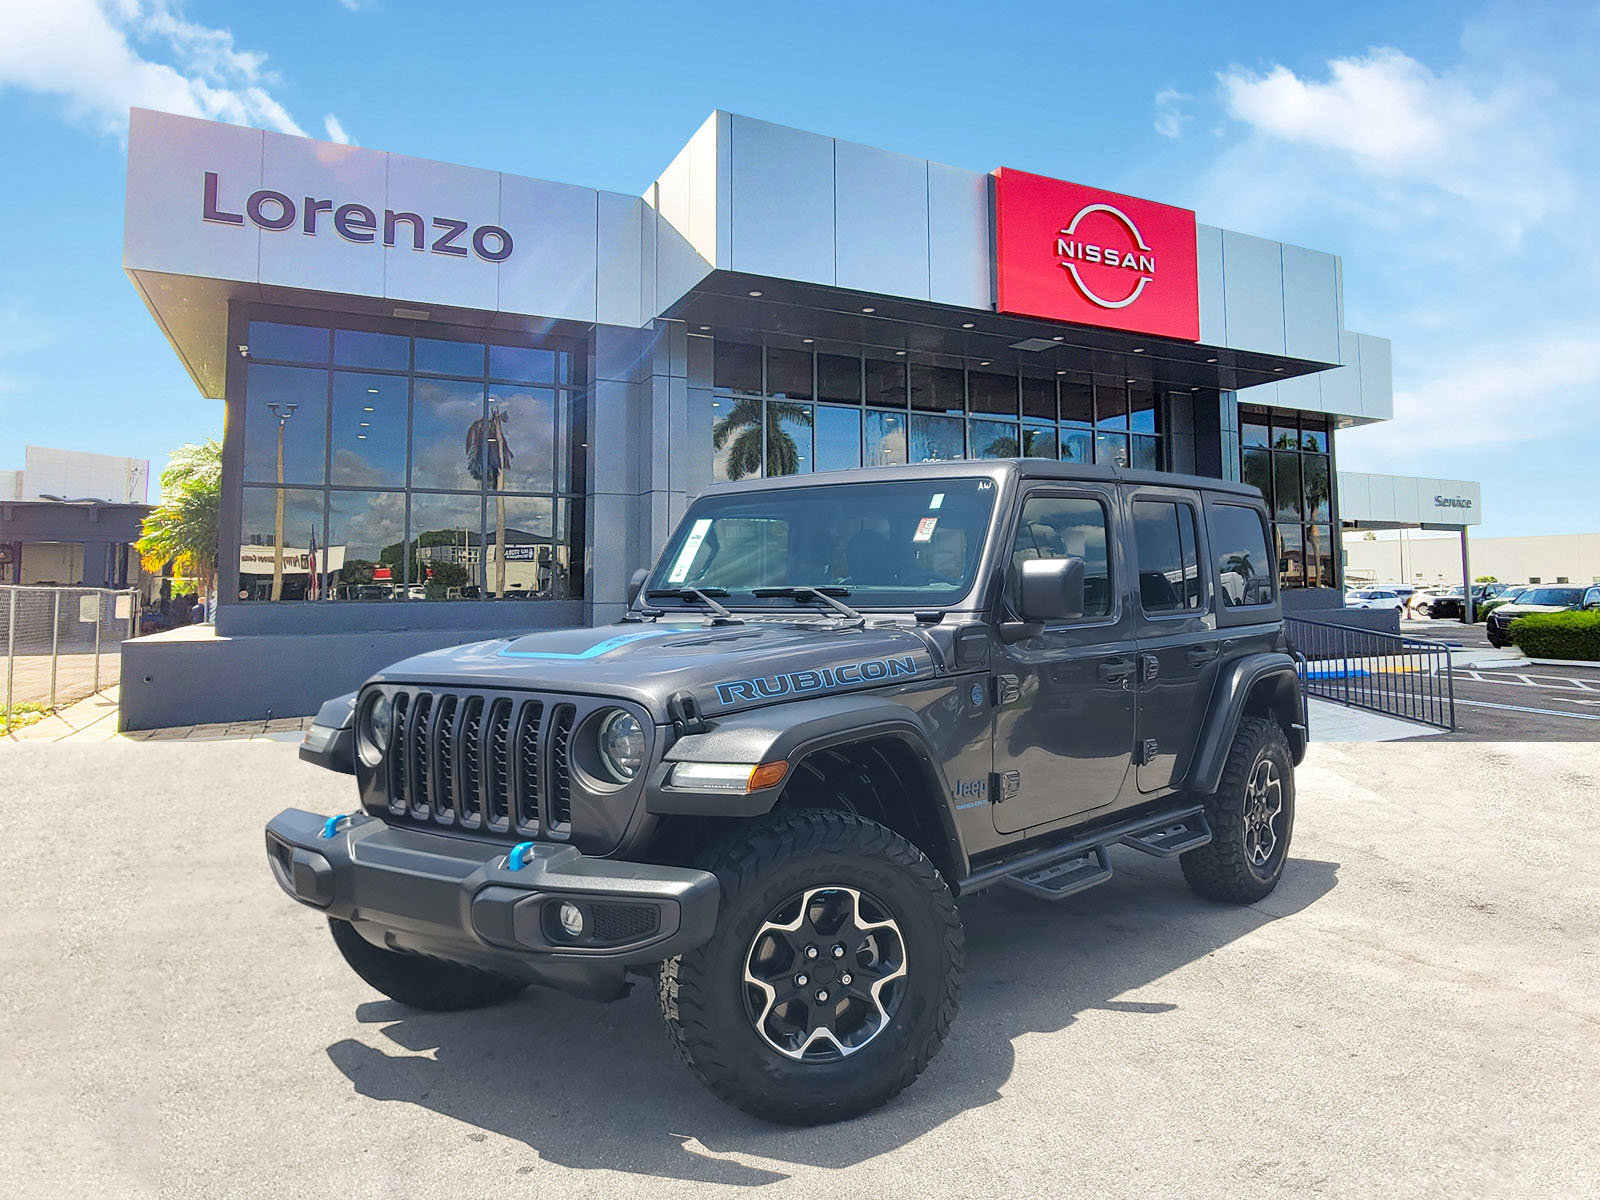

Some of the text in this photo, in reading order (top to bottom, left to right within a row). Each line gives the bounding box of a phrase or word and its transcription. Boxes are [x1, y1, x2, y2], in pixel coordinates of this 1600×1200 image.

[202, 171, 514, 263] Lorenzo
[1057, 238, 1155, 273] NISSAN
[977, 480, 992, 492] AW
[1434, 495, 1472, 509] Service
[714, 656, 918, 705] RUBICON
[951, 779, 987, 800] Jeep
